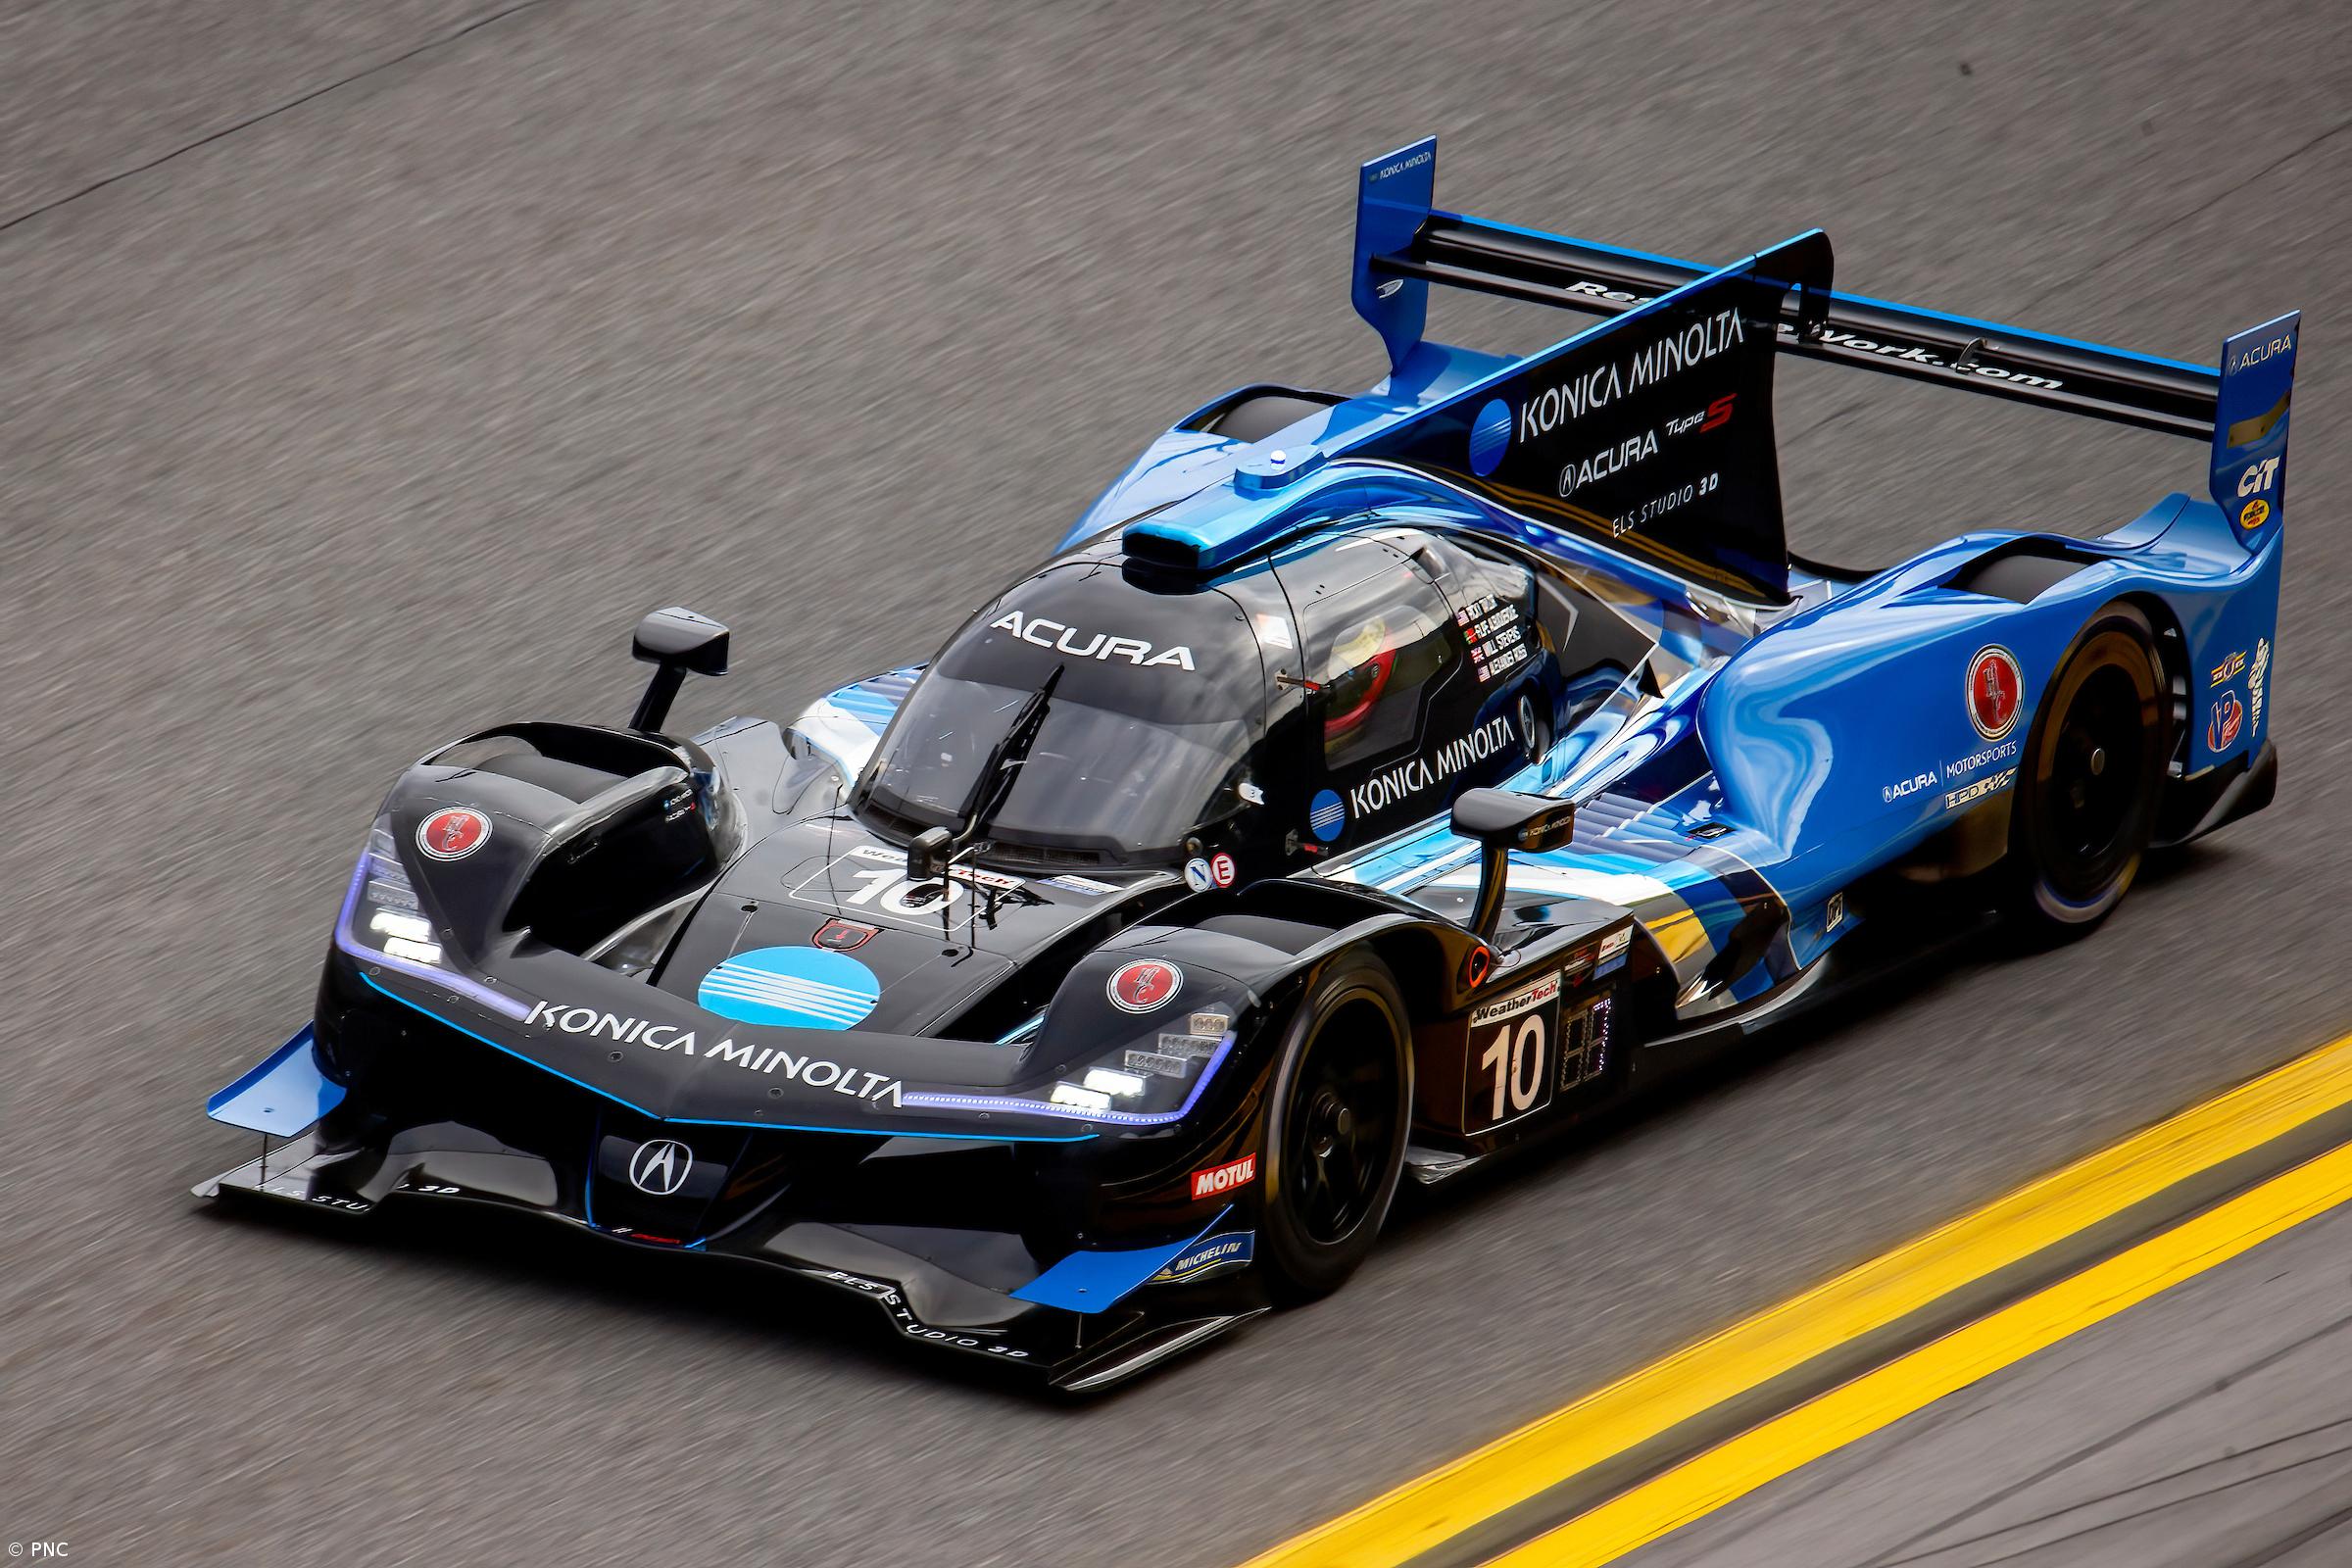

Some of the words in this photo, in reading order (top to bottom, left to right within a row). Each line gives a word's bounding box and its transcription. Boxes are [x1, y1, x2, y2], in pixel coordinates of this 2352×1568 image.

[1520, 362, 1622, 444] KONICA
[1629, 306, 1744, 394] MINOLTA
[2239, 334, 2291, 370] ACURA
[1576, 428, 1659, 490] ACURA
[1665, 411, 1706, 436] Type
[1612, 510, 1635, 539] ELS
[1641, 484, 1693, 523] STUDIO
[1698, 472, 1719, 496] 3D
[990, 611, 1196, 671] ACURA
[1350, 758, 1434, 819] KONICA
[1437, 715, 1515, 781] MINOLTA
[1892, 770, 1937, 800] ACURA
[1946, 740, 2017, 779] MOTORSPORTS
[846, 868, 964, 915] 10
[1216, 859, 1231, 881] E
[1476, 980, 1557, 1020] WeatherTech
[524, 1001, 695, 1055] KONICA
[704, 1039, 902, 1108] MINOLTA
[1482, 1014, 1545, 1121] 10
[417, 1185, 461, 1194] 3D
[1196, 1158, 1254, 1196] MOTUL
[1176, 1242, 1242, 1271] MICHELIN
[826, 1271, 879, 1291] ELS
[884, 1293, 979, 1348] STUDIO
[988, 1346, 1029, 1358] 3D
